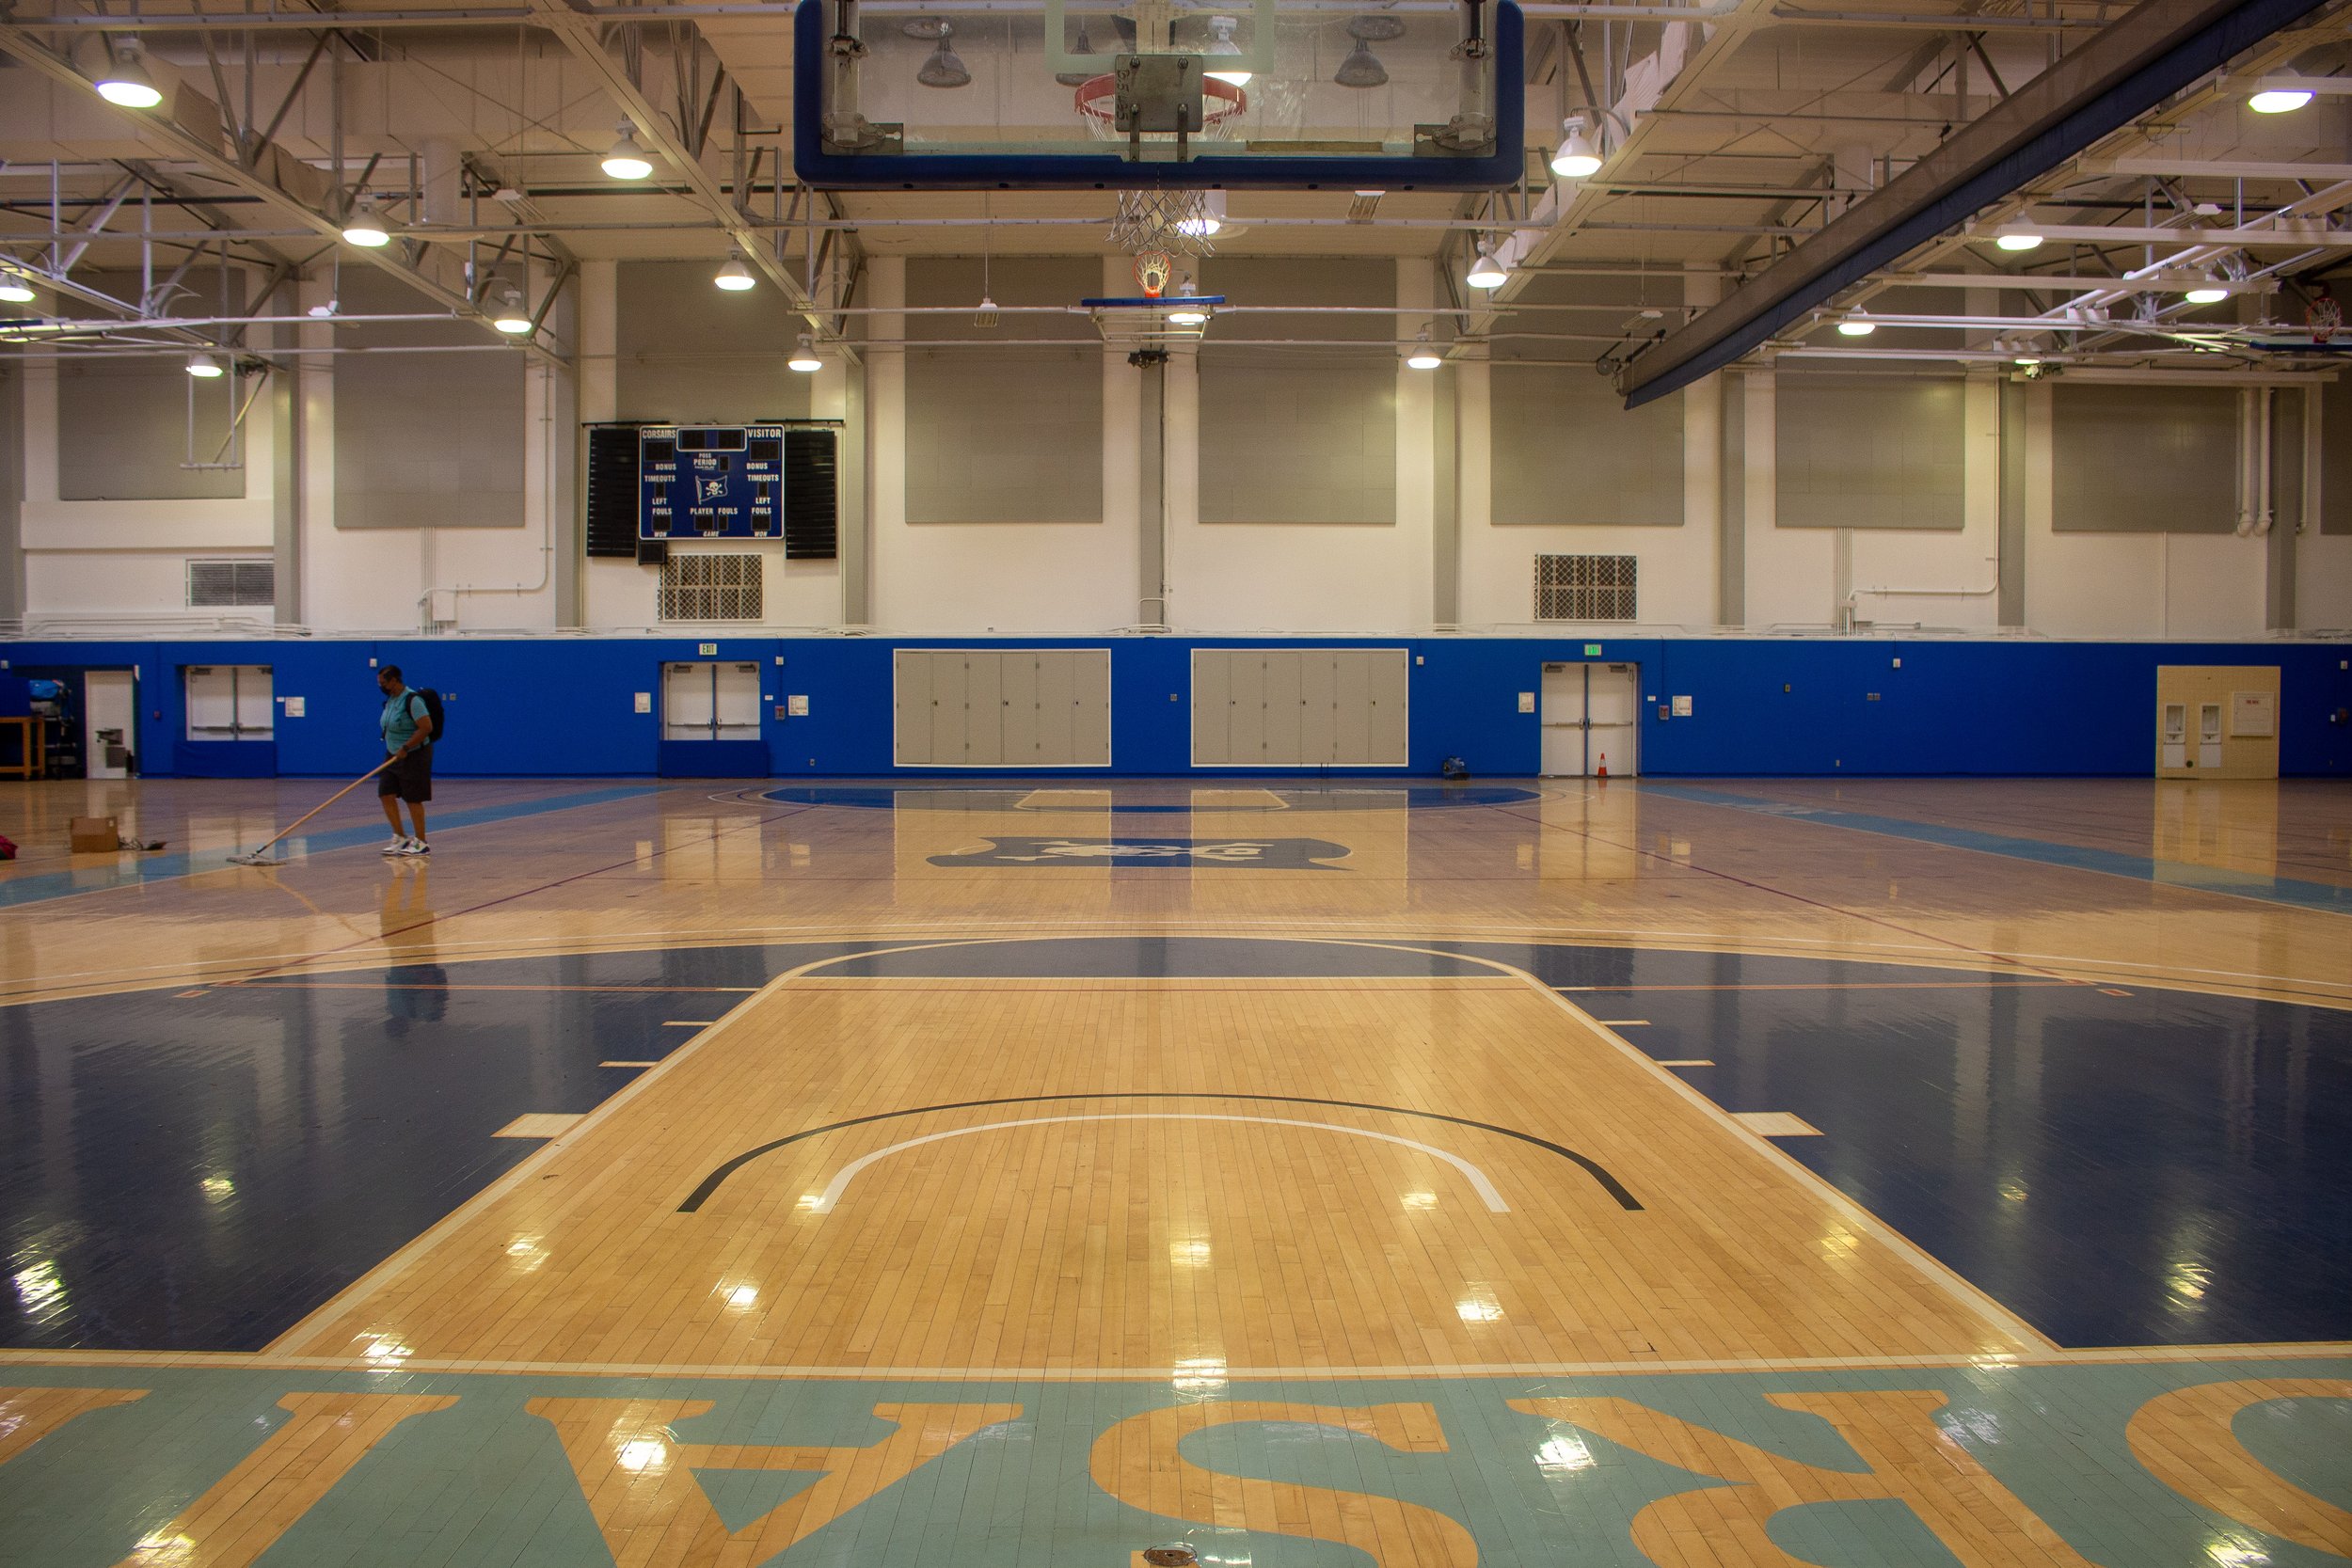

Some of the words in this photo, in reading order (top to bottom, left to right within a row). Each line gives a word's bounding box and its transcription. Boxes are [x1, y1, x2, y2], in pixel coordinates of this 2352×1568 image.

[642, 429, 676, 439] CORSAIRS
[748, 429, 782, 438] VISITOR
[702, 644, 715, 654] EXIT
